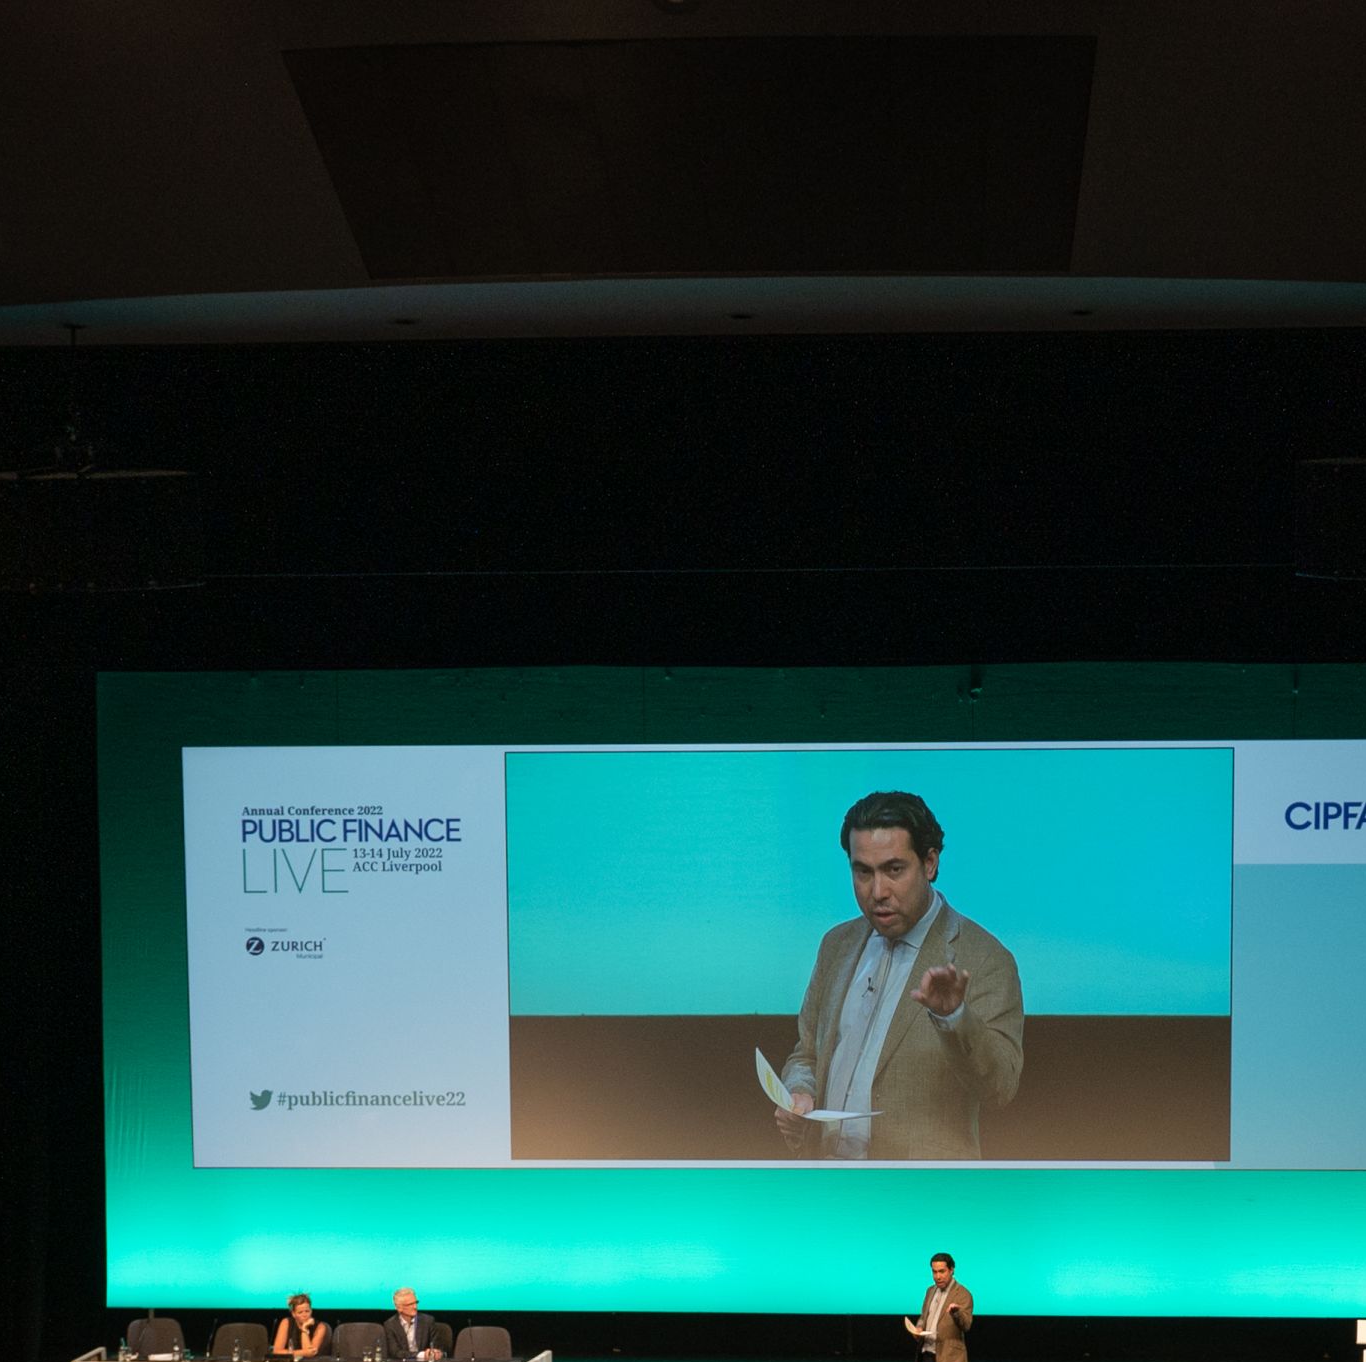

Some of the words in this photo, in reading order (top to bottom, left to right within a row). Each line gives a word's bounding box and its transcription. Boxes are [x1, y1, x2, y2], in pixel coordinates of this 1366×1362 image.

[242, 806, 284, 816] Annual
[287, 806, 355, 816] Conference
[357, 805, 383, 816] 2022
[242, 818, 337, 843] PUBLIC
[343, 818, 462, 843] FINANCE
[353, 848, 383, 859] 13-14
[386, 848, 411, 862] July
[414, 848, 443, 859] 2022
[243, 848, 349, 893] LIVE
[352, 861, 378, 872] ACC
[382, 861, 442, 874] Liverpool
[271, 940, 323, 952] ZURICH
[277, 1090, 466, 1111] #publicfinancelive22
